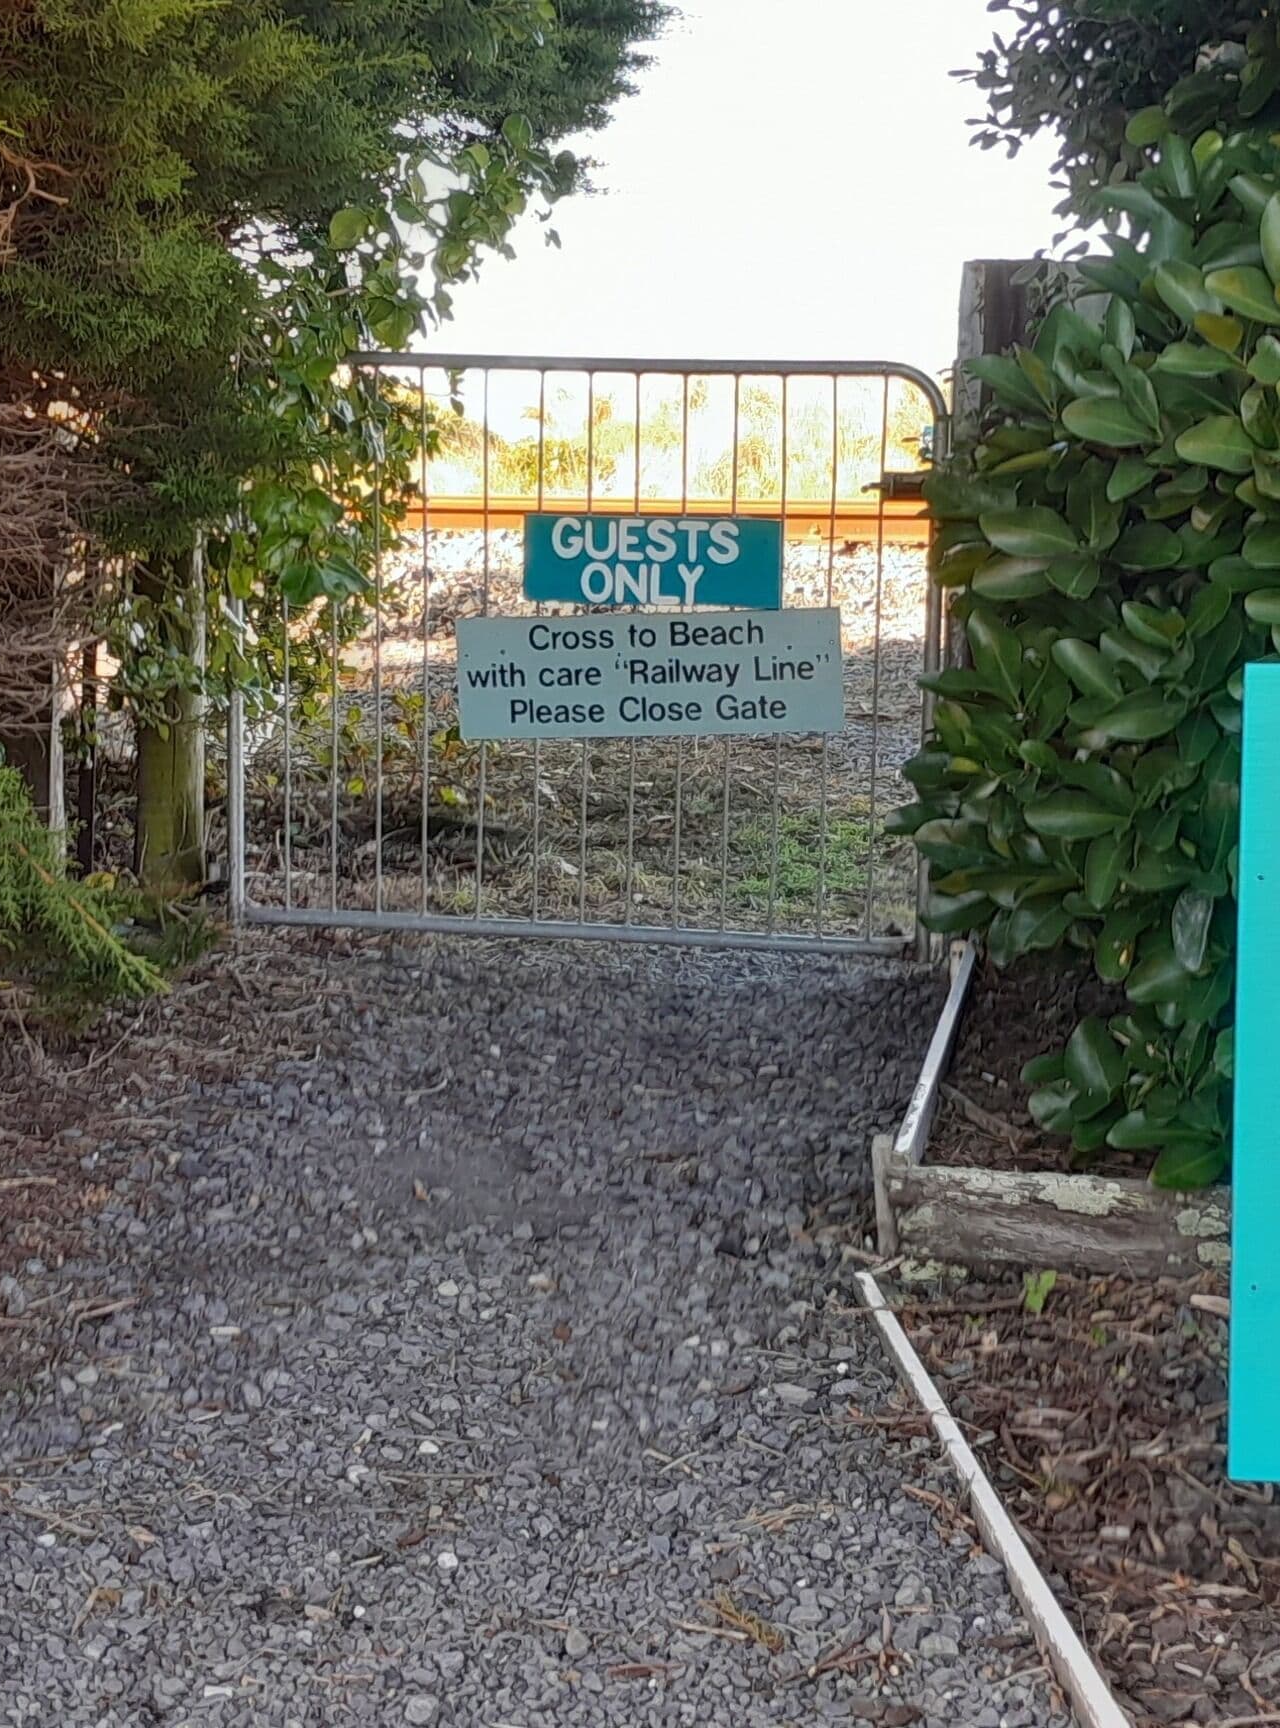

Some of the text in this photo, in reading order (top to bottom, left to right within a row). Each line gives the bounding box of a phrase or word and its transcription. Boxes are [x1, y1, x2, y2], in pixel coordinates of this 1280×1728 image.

[551, 517, 740, 564] GUESTS
[580, 562, 705, 606] ONLY
[528, 620, 764, 651] Cross to Beach
[466, 662, 526, 688] with
[538, 665, 602, 686] care
[509, 694, 787, 724] Please Close Gate
